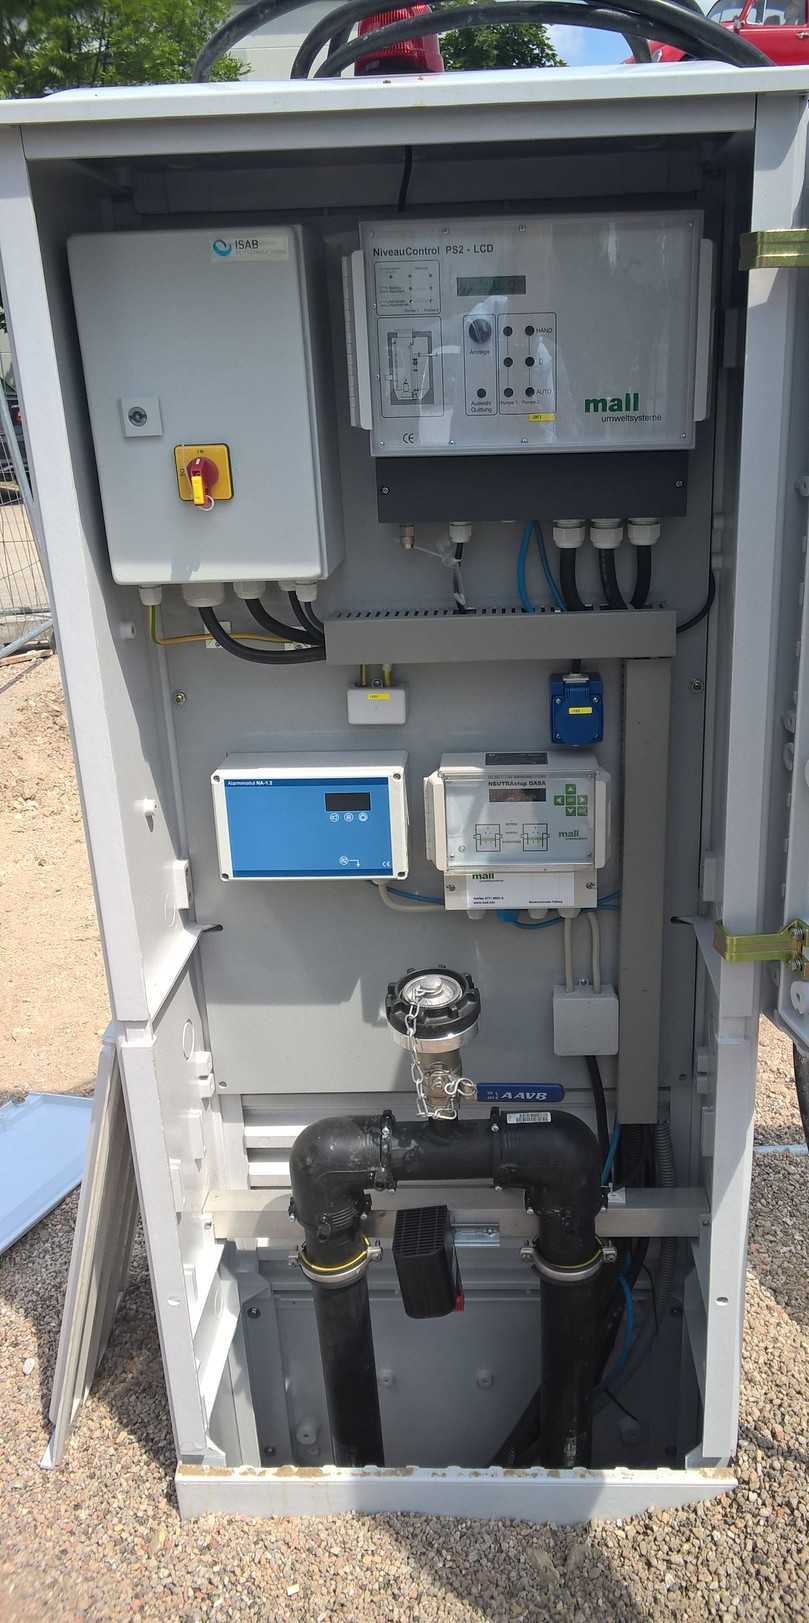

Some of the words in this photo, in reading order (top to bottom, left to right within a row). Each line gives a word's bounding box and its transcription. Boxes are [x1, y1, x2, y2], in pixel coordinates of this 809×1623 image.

[235, 239, 259, 249] ISAB
[373, 246, 440, 256] NiveauControl
[445, 245, 464, 254] PS2
[473, 244, 494, 253] LCD
[584, 393, 639, 413] mall
[601, 414, 662, 423] umweltsysteme
[558, 830, 580, 839] mall
[472, 872, 495, 880] mall
